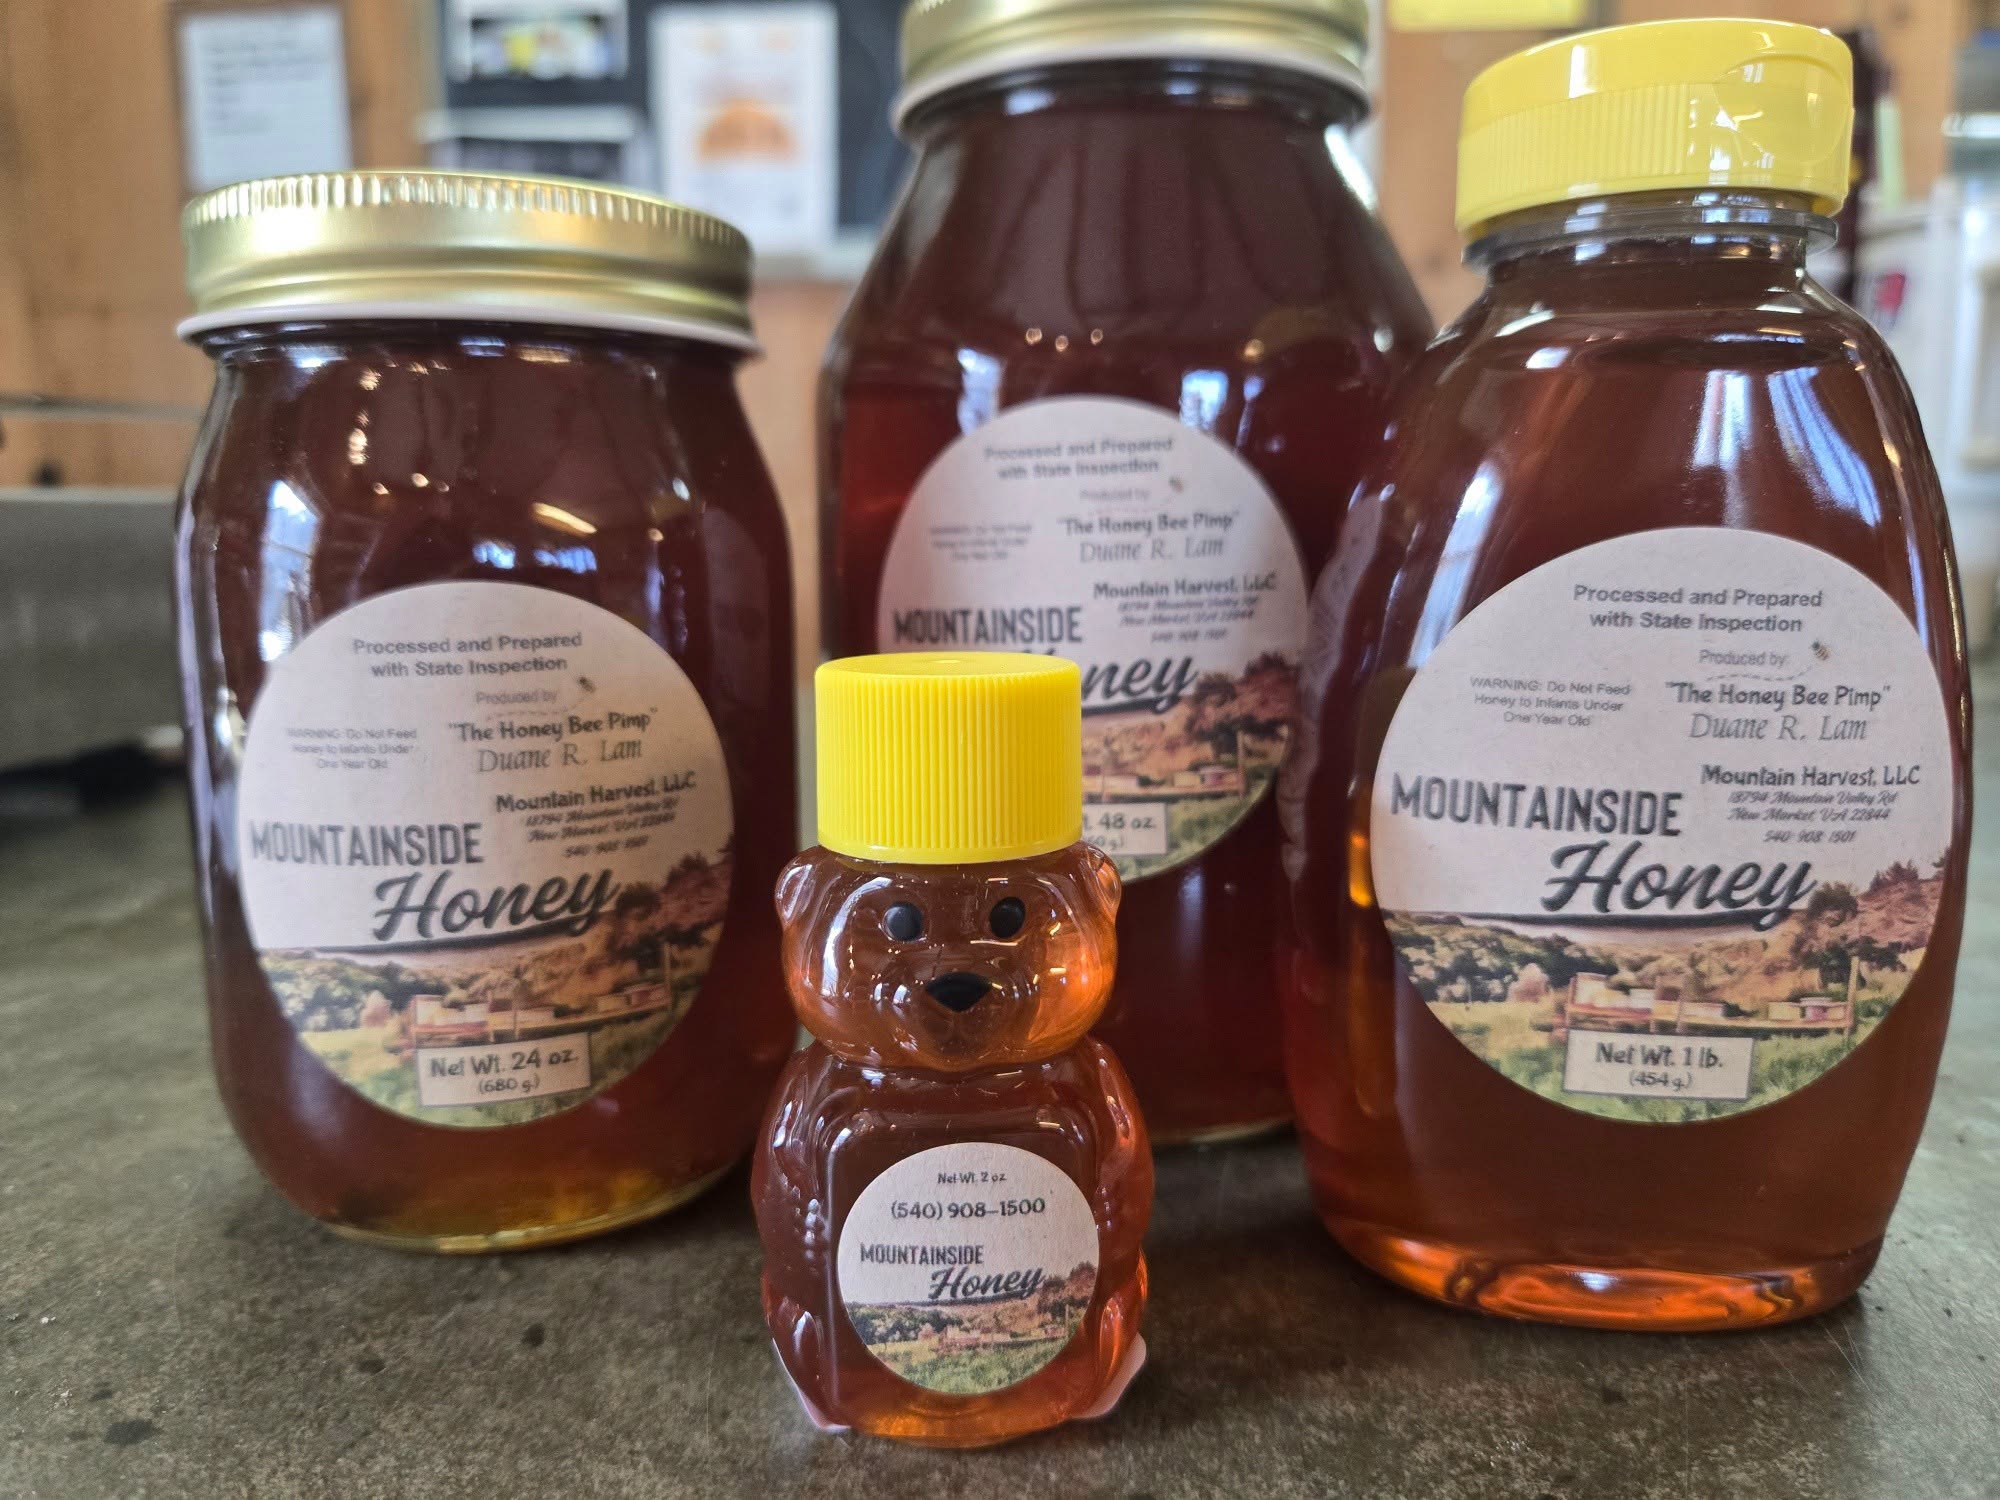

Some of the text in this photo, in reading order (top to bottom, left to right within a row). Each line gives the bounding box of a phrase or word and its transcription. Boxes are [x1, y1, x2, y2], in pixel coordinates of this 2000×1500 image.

[1066, 440, 1096, 457] and
[1101, 436, 1175, 455] Prepared
[998, 458, 1159, 480] with State Inspection
[1099, 513, 1152, 538] Honey
[1156, 512, 1189, 532] Bee
[1079, 539, 1143, 564] Duane
[1093, 581, 1170, 599] Mountain
[1242, 569, 1278, 591] LLC
[1573, 584, 1824, 609] Processed and Prepared
[892, 606, 1083, 645] MOUNTAINSIDE
[1590, 611, 1803, 633] with State Inspection
[352, 632, 583, 655] Processed and Prepared
[371, 656, 568, 677] with State Inspection
[1699, 650, 1765, 667] Produced
[475, 690, 540, 705] Produced
[1081, 655, 1199, 715] ney
[1546, 680, 1567, 693] Do
[1569, 682, 1593, 694] Not
[1596, 683, 1632, 696] Feed
[1665, 682, 1892, 712] "The Honey Bee Pimp"
[1474, 693, 1624, 712] Honey to Infants Under
[448, 707, 659, 744] "The Honey Bee Pimp"
[1503, 711, 1592, 727] One Year Old
[1688, 713, 1868, 741] Duane R. Lam
[478, 738, 643, 774] Duane R. Lam
[1700, 763, 1795, 787] Mountain
[1882, 764, 1921, 785] LLC
[495, 790, 585, 812] Mountain
[662, 770, 697, 793] LLC
[1391, 772, 1683, 838] MOUNTAINSIDE
[1097, 812, 1126, 831] 48
[249, 820, 484, 867] MOUNTAINSIDE
[1540, 840, 1818, 932] Honey
[372, 868, 623, 943] Honey
[430, 1056, 466, 1078] Net
[470, 1053, 506, 1076] Wt.
[511, 1047, 542, 1072] 24
[1595, 1041, 1724, 1069] Net Wt. 1 lb.
[479, 1077, 519, 1095] (680
[1629, 1069, 1693, 1092] (454 g.)
[937, 1171, 957, 1184] Net
[980, 1171, 989, 1183] 2
[891, 1200, 943, 1221] (540)
[860, 1241, 984, 1266] MOUNTAINSIDE
[928, 1265, 1045, 1300] Honey
